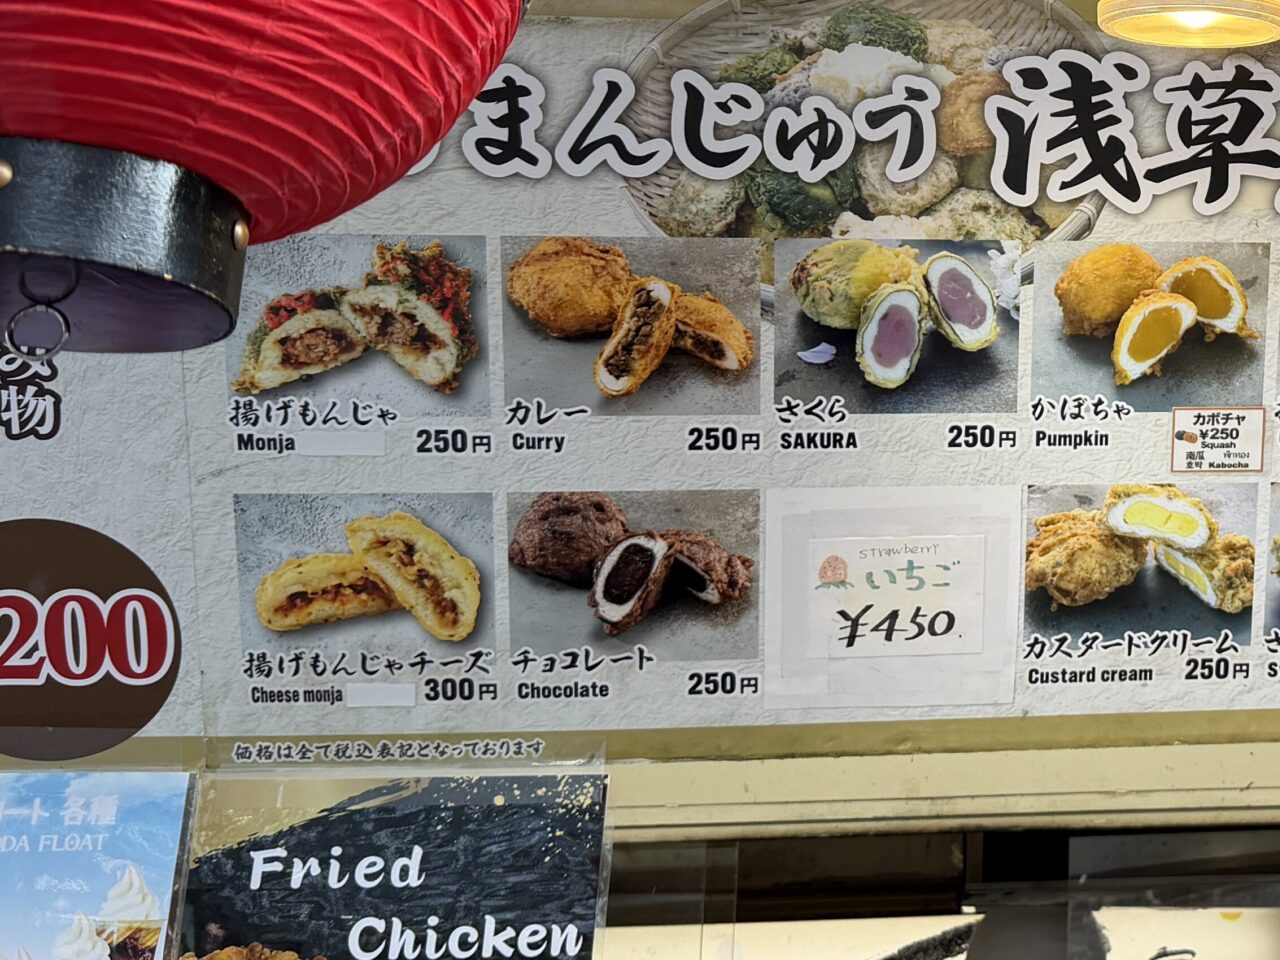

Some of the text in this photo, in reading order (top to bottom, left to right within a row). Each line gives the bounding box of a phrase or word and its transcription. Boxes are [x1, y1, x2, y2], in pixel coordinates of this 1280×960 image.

[229, 398, 398, 428] 揚げもんじゃ
[505, 400, 589, 425] カレー
[775, 398, 847, 423] さくら
[1031, 397, 1132, 421] かぼちゃ
[1193, 412, 1247, 426] カボチャ
[236, 433, 296, 454] Monja
[512, 433, 565, 452] Curry
[780, 431, 858, 449] SAKURA
[1035, 430, 1109, 450] Pumpkin
[1199, 428, 1240, 440] ¥250
[1201, 441, 1237, 450] Squash
[1208, 461, 1250, 469] Kabocha
[865, 559, 961, 591] いちご
[1022, 631, 1240, 660] カスタードクリーム
[243, 650, 492, 679] 揚げもんじゃチーズ
[511, 646, 655, 674] チョコレート
[1028, 667, 1153, 684] Custard cream
[251, 685, 343, 706] Cheese monja
[517, 682, 610, 700] Chocolate
[0, 794, 119, 826] ート 各種
[0, 833, 110, 852] DA FLOAT
[249, 845, 426, 891] Fried
[346, 915, 583, 959] Chicken
